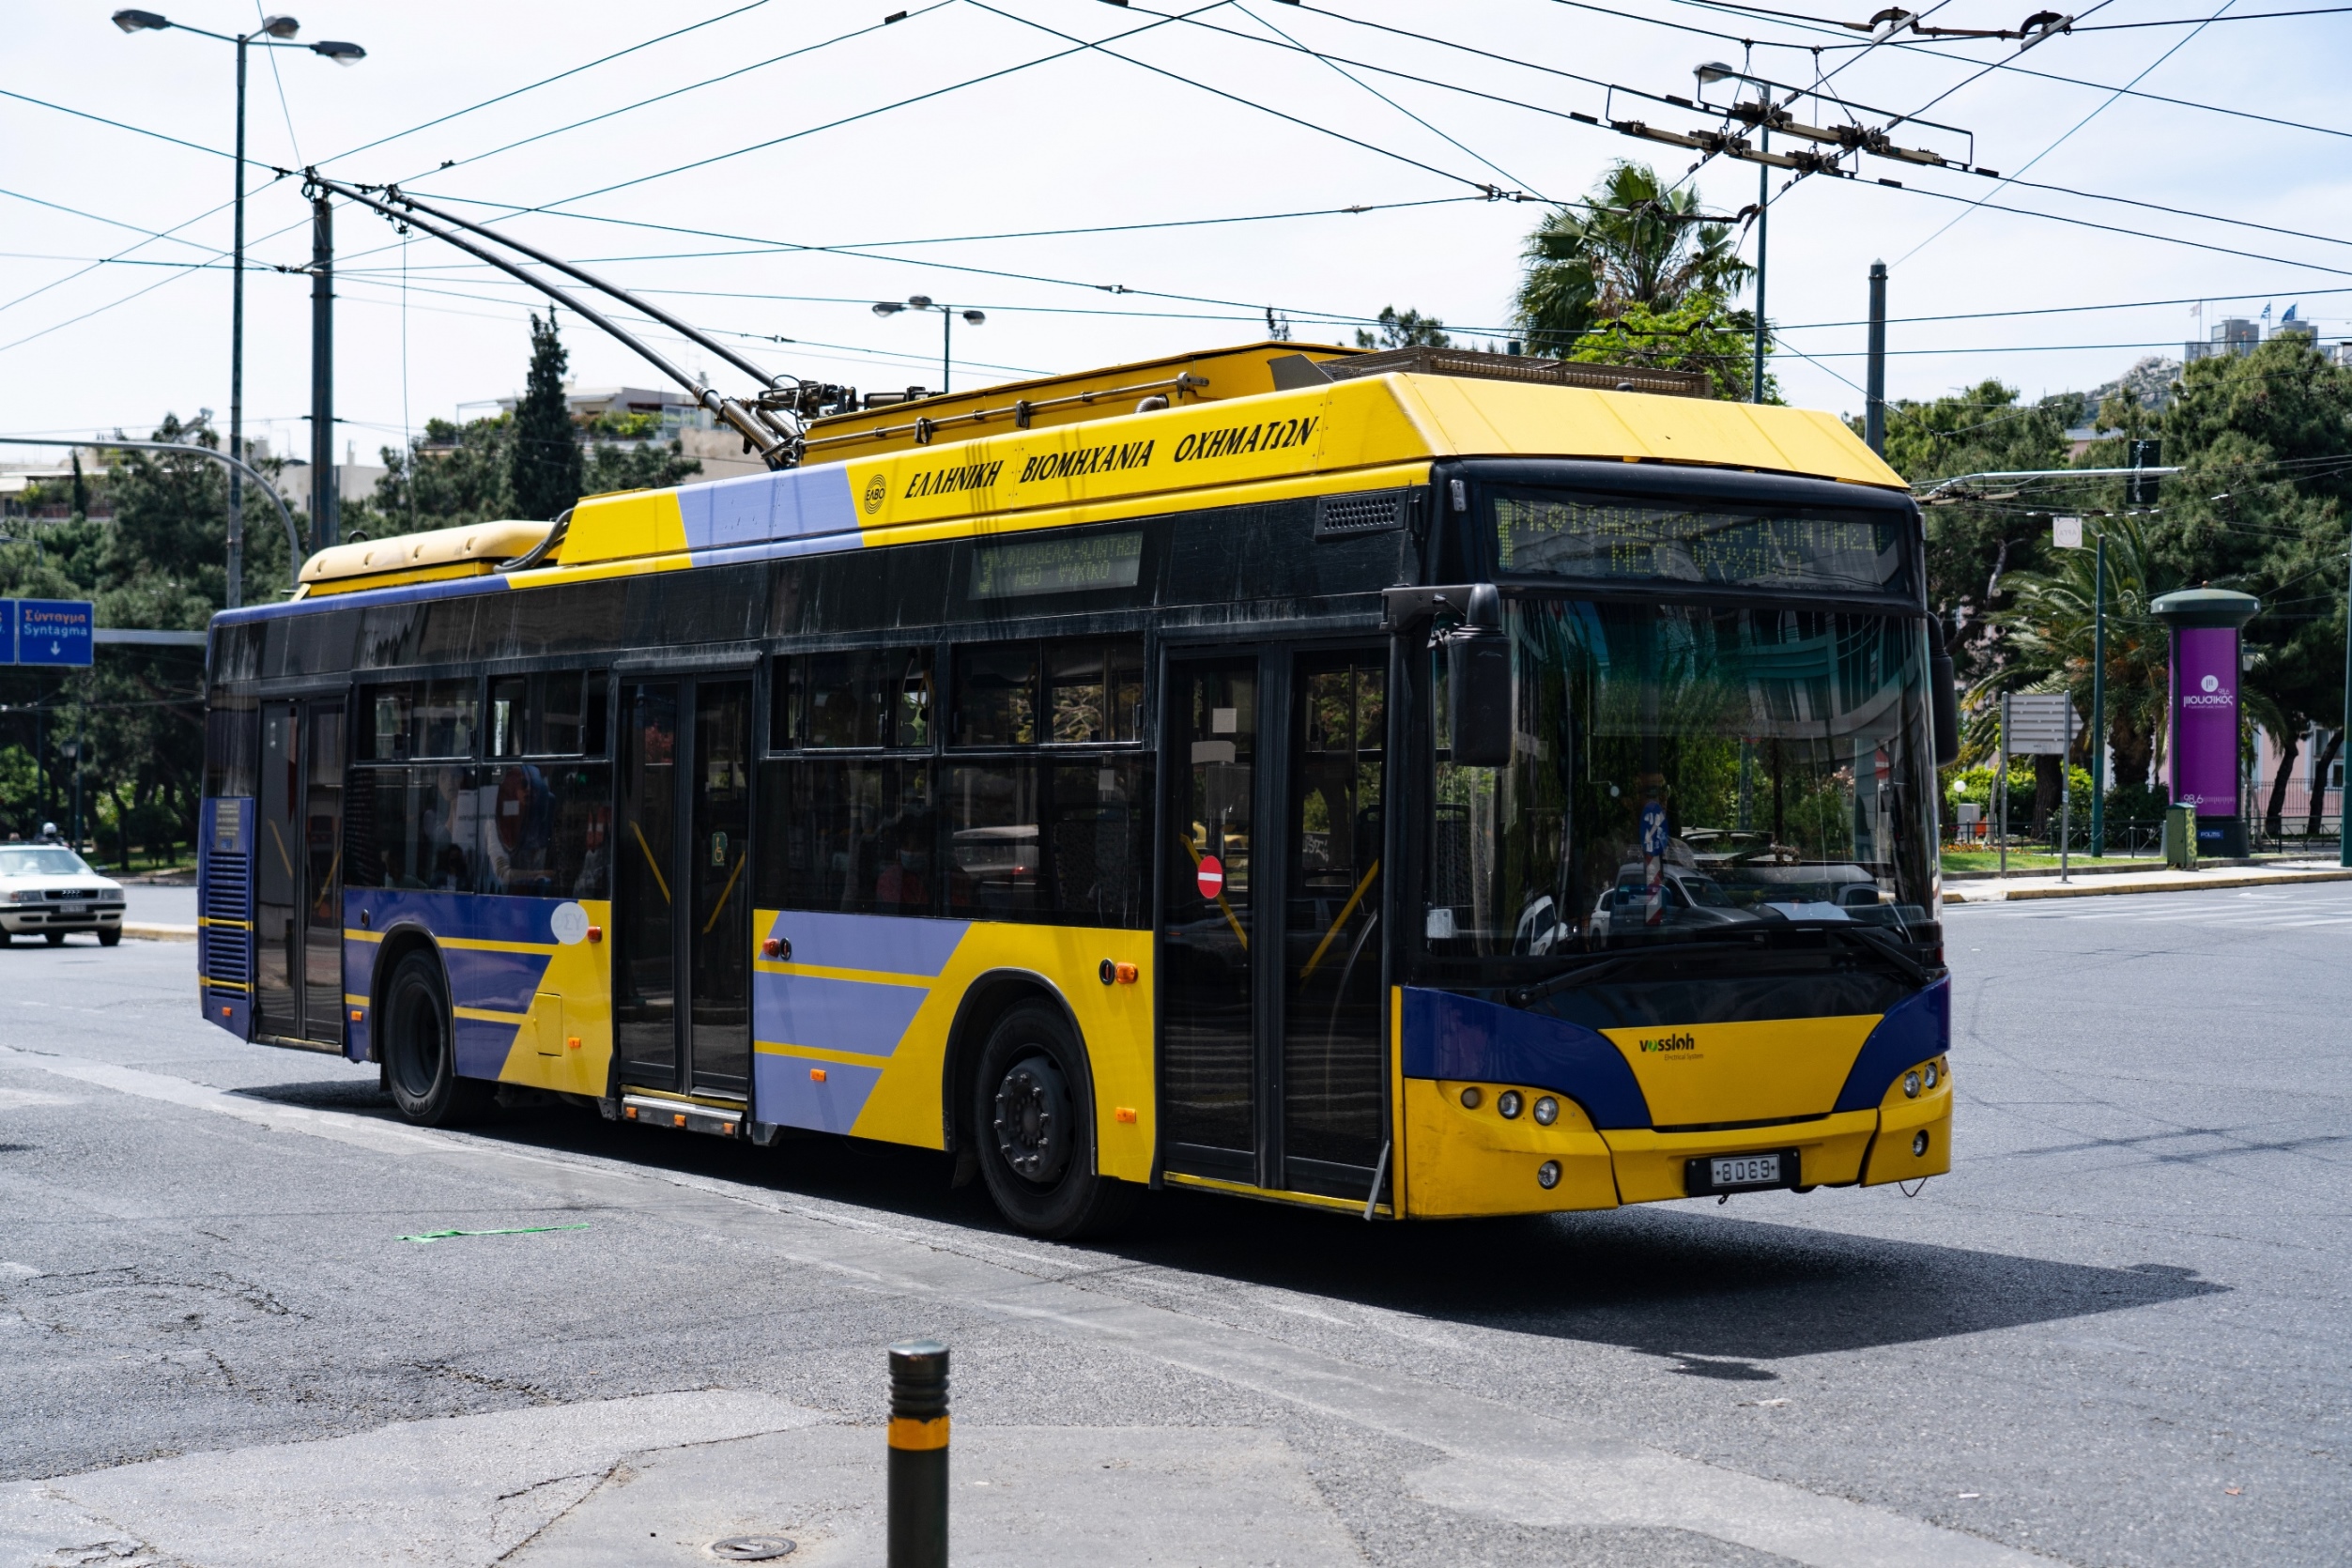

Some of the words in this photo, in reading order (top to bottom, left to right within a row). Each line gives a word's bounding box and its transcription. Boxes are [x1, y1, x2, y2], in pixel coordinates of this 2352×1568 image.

[904, 460, 1005, 500] ΕΛΛΗΝΙΚΗ
[1019, 439, 1156, 484] ΒΙΟΜΗΧΑΝΙΑ
[1174, 416, 1319, 463] ΟΧΗΜΑΤΩΝ
[24, 608, 85, 624] Σύνταγμα
[23, 623, 88, 638] Syntagma
[2183, 693, 2234, 708] μουσικός
[2183, 793, 2204, 805] 98,6
[1638, 1032, 1695, 1053] vossloh
[1721, 1160, 1771, 1182] 8069
